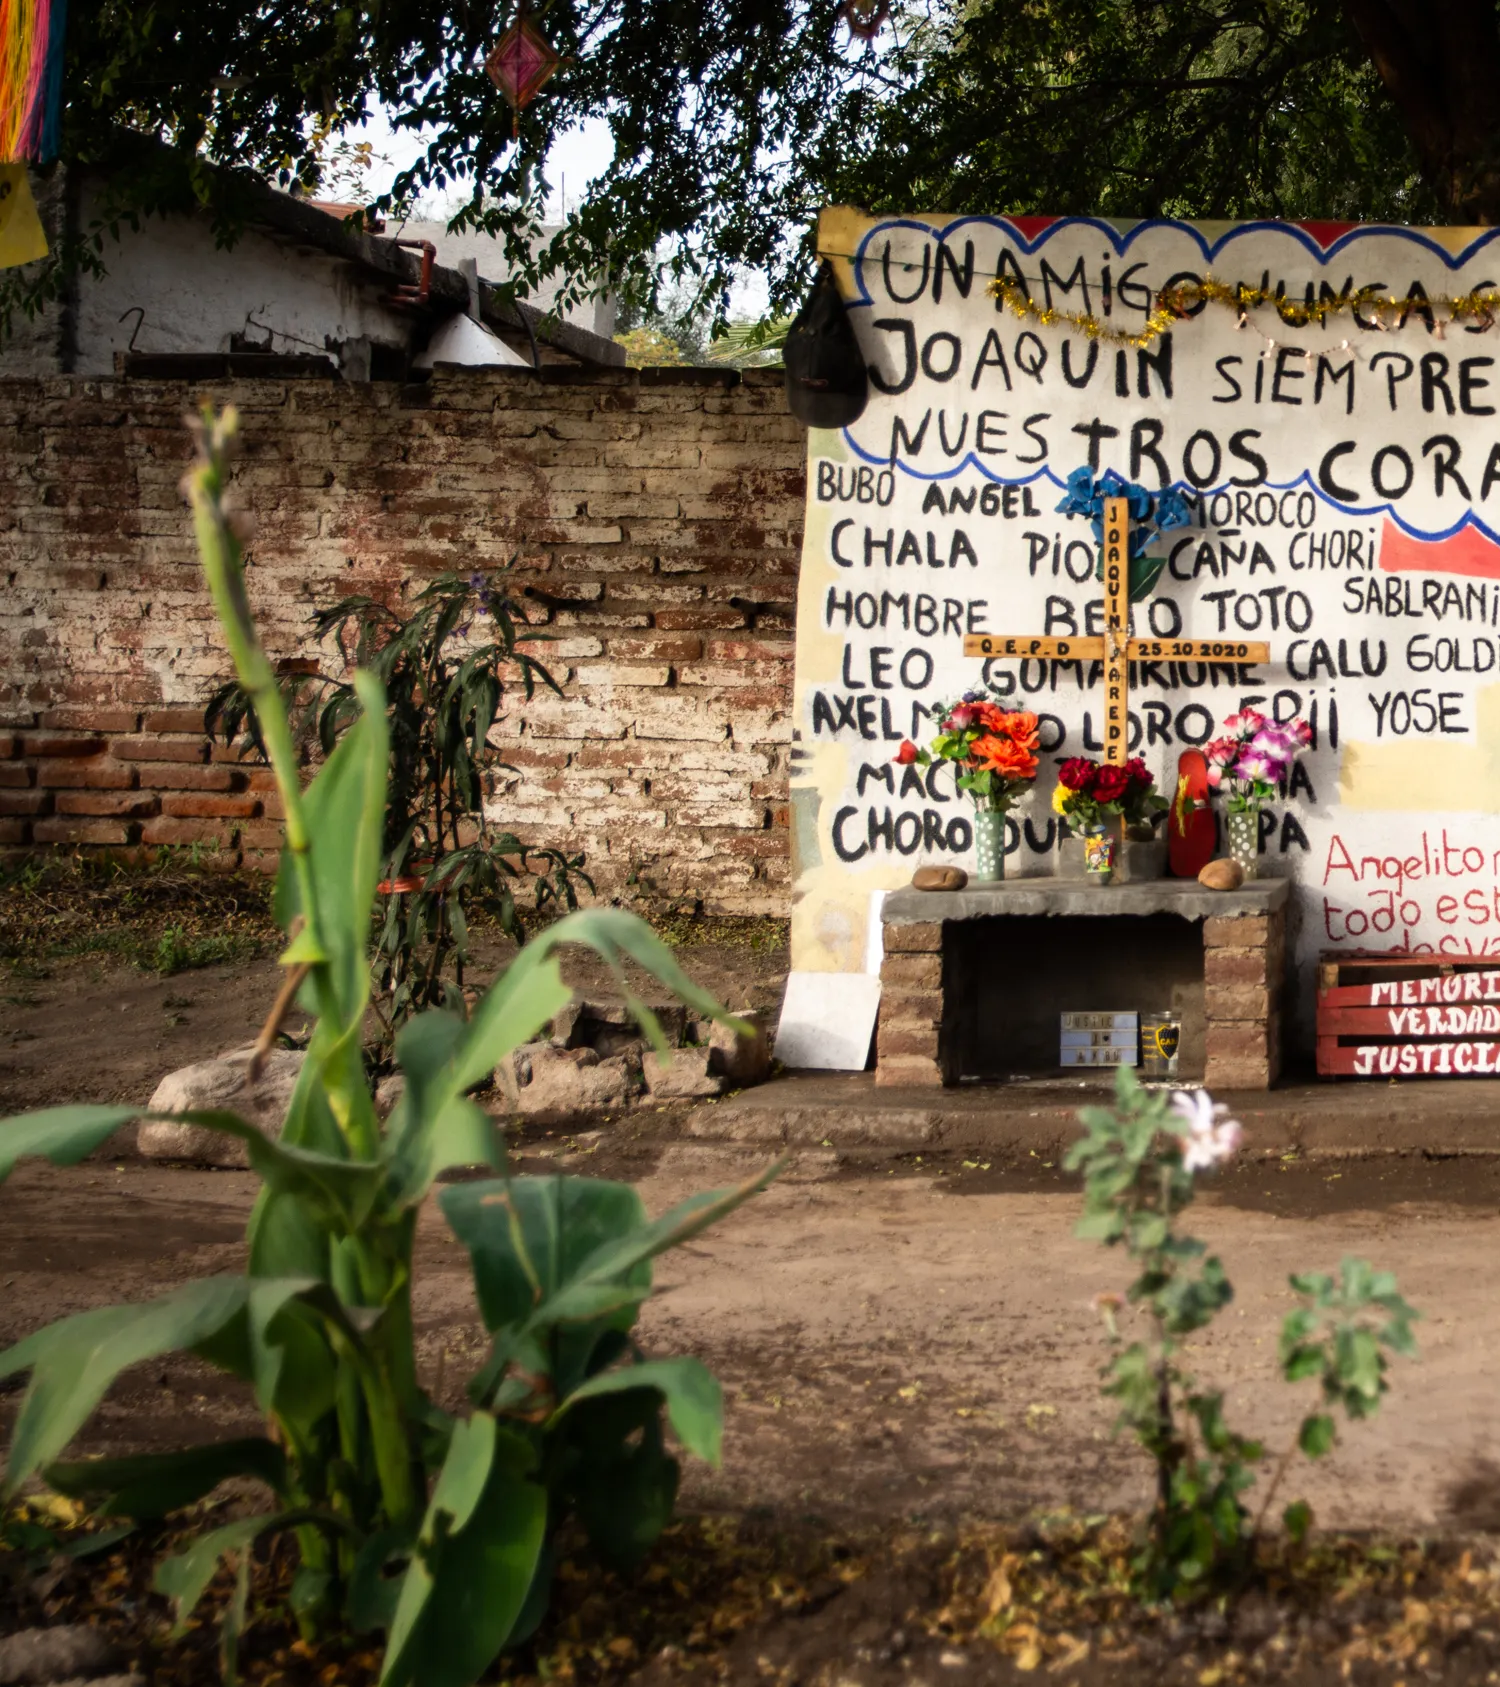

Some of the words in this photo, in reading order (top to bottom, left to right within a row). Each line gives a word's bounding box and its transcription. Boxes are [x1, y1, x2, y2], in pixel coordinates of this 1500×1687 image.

[883, 239, 975, 304] UN
[1237, 269, 1435, 334] NUNCA
[869, 318, 1173, 398] JOAQUIN
[890, 409, 1269, 489] NUESTROS
[817, 460, 896, 507] BUBO
[922, 481, 1041, 518] ANGEL
[831, 518, 978, 569] CHALA
[1169, 529, 1276, 580] CAÑA
[1107, 506, 1121, 628] JOAQUIN
[827, 586, 988, 637] HOMBRE
[1201, 586, 1314, 633] TOTO
[842, 643, 935, 690] LEO
[1286, 638, 1387, 681] CALU
[813, 691, 904, 741] AXEL
[1368, 688, 1469, 737] YOSE
[831, 805, 973, 863] CHORO
[1323, 829, 1485, 896] Angelito
[1323, 889, 1421, 941] todo
